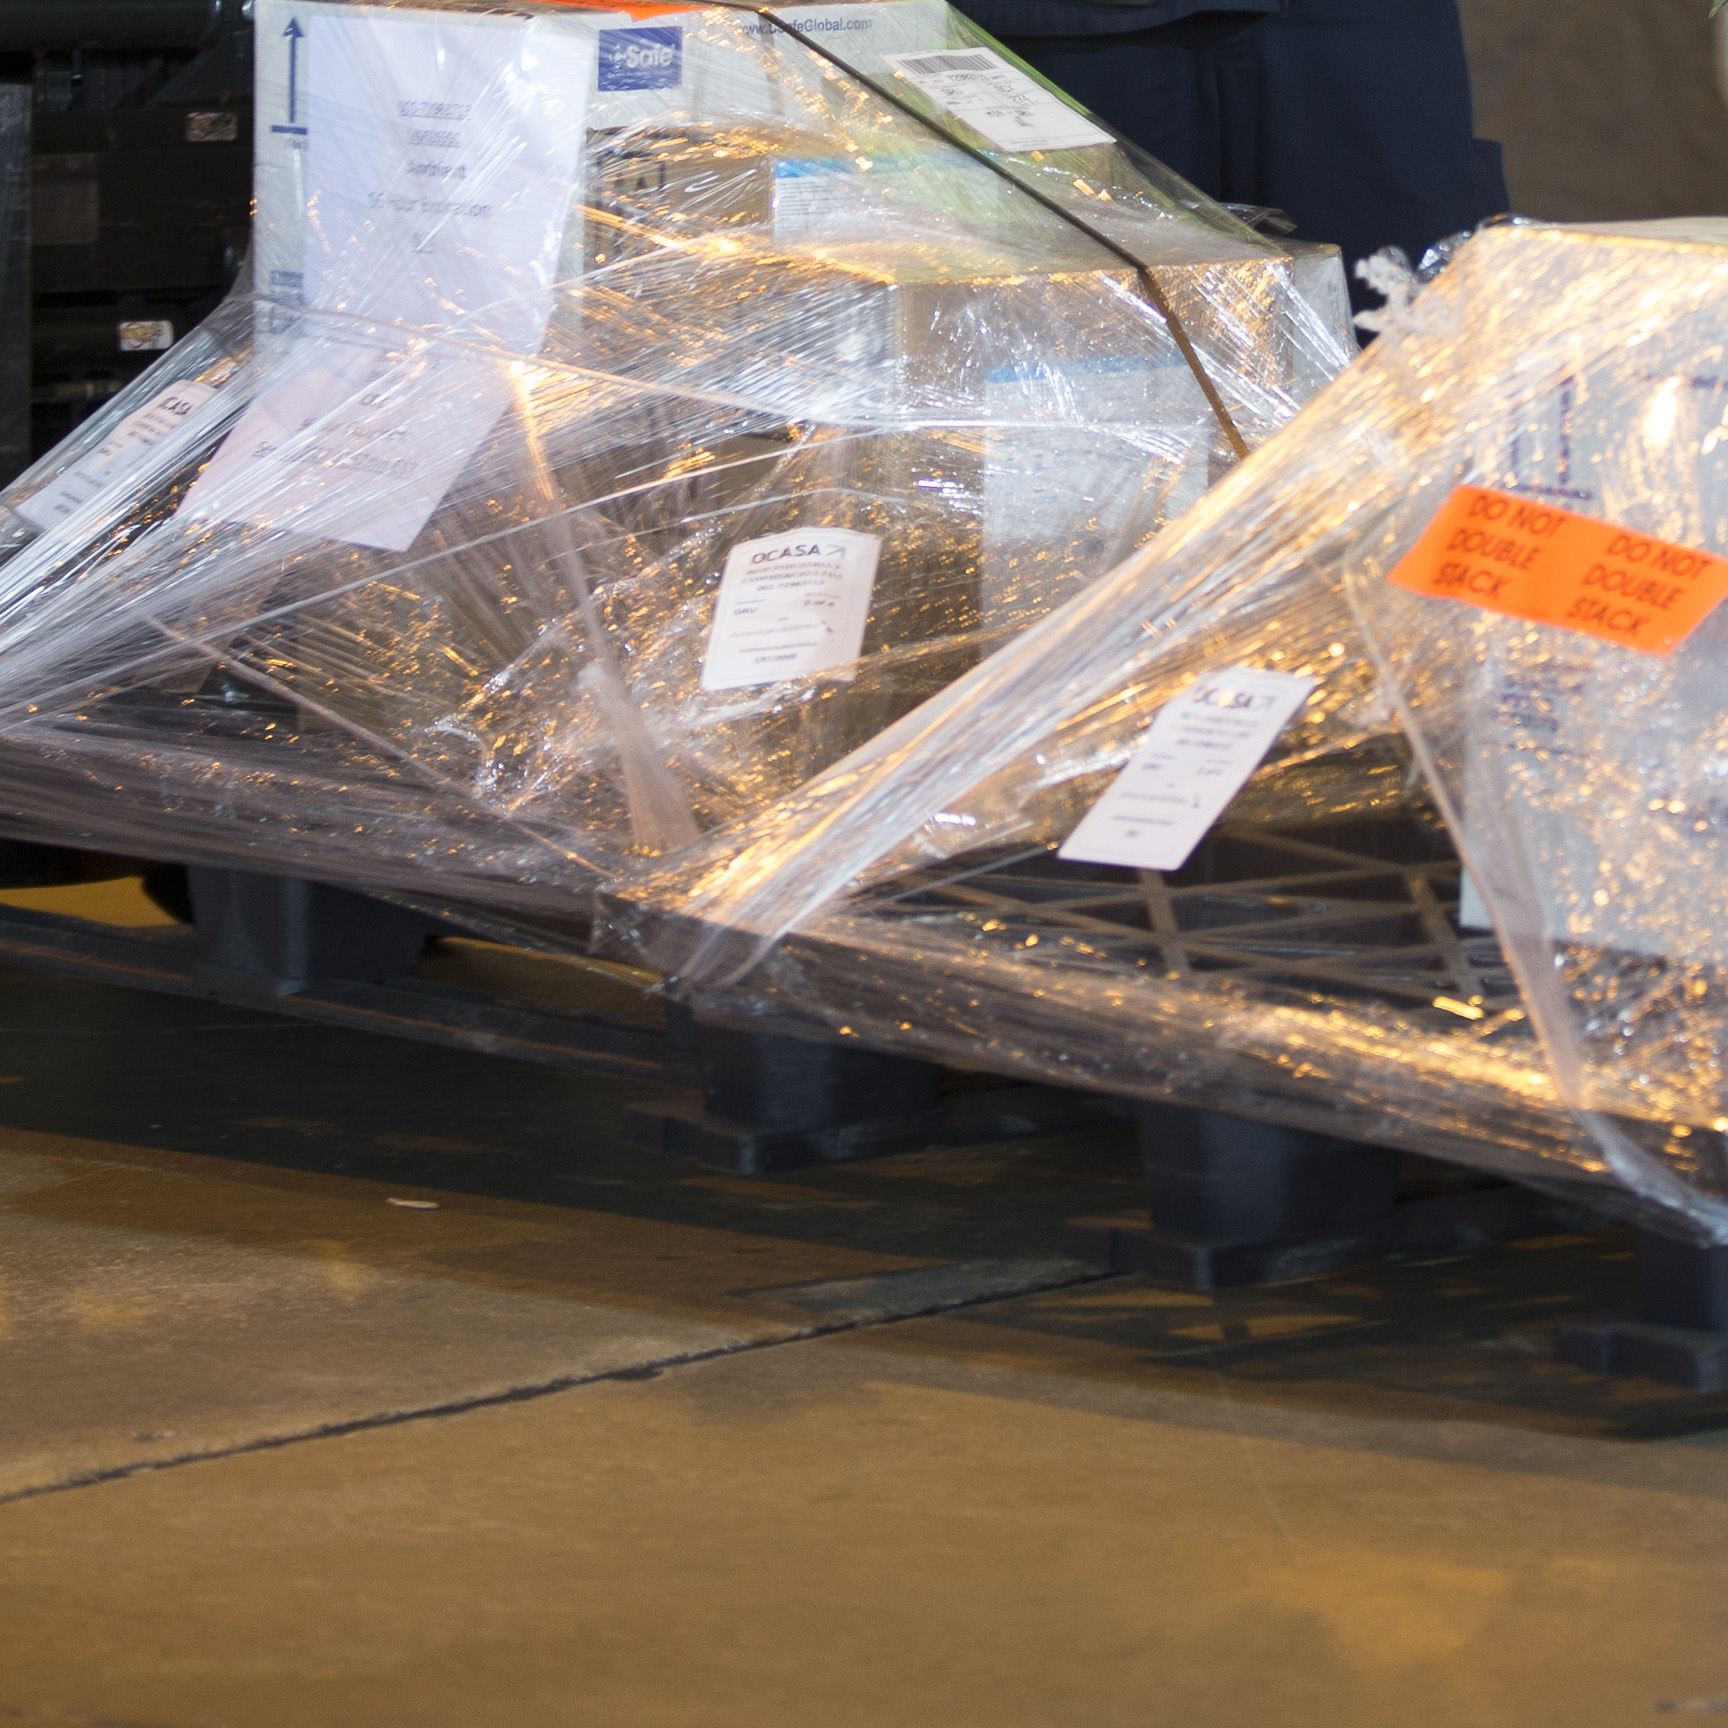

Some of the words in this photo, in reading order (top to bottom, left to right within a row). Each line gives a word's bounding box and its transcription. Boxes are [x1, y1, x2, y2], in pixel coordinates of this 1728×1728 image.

[1468, 494, 1509, 522] DO
[1507, 505, 1568, 539] NOT
[752, 544, 821, 565] OCASA
[1445, 528, 1544, 571] DOUBLE
[1605, 534, 1651, 563] DO
[1649, 548, 1715, 581] NOT
[1431, 562, 1511, 600] STACK
[1581, 563, 1685, 610] DOUBLE
[1566, 597, 1652, 637] STACK
[1192, 685, 1254, 710] OCSA
